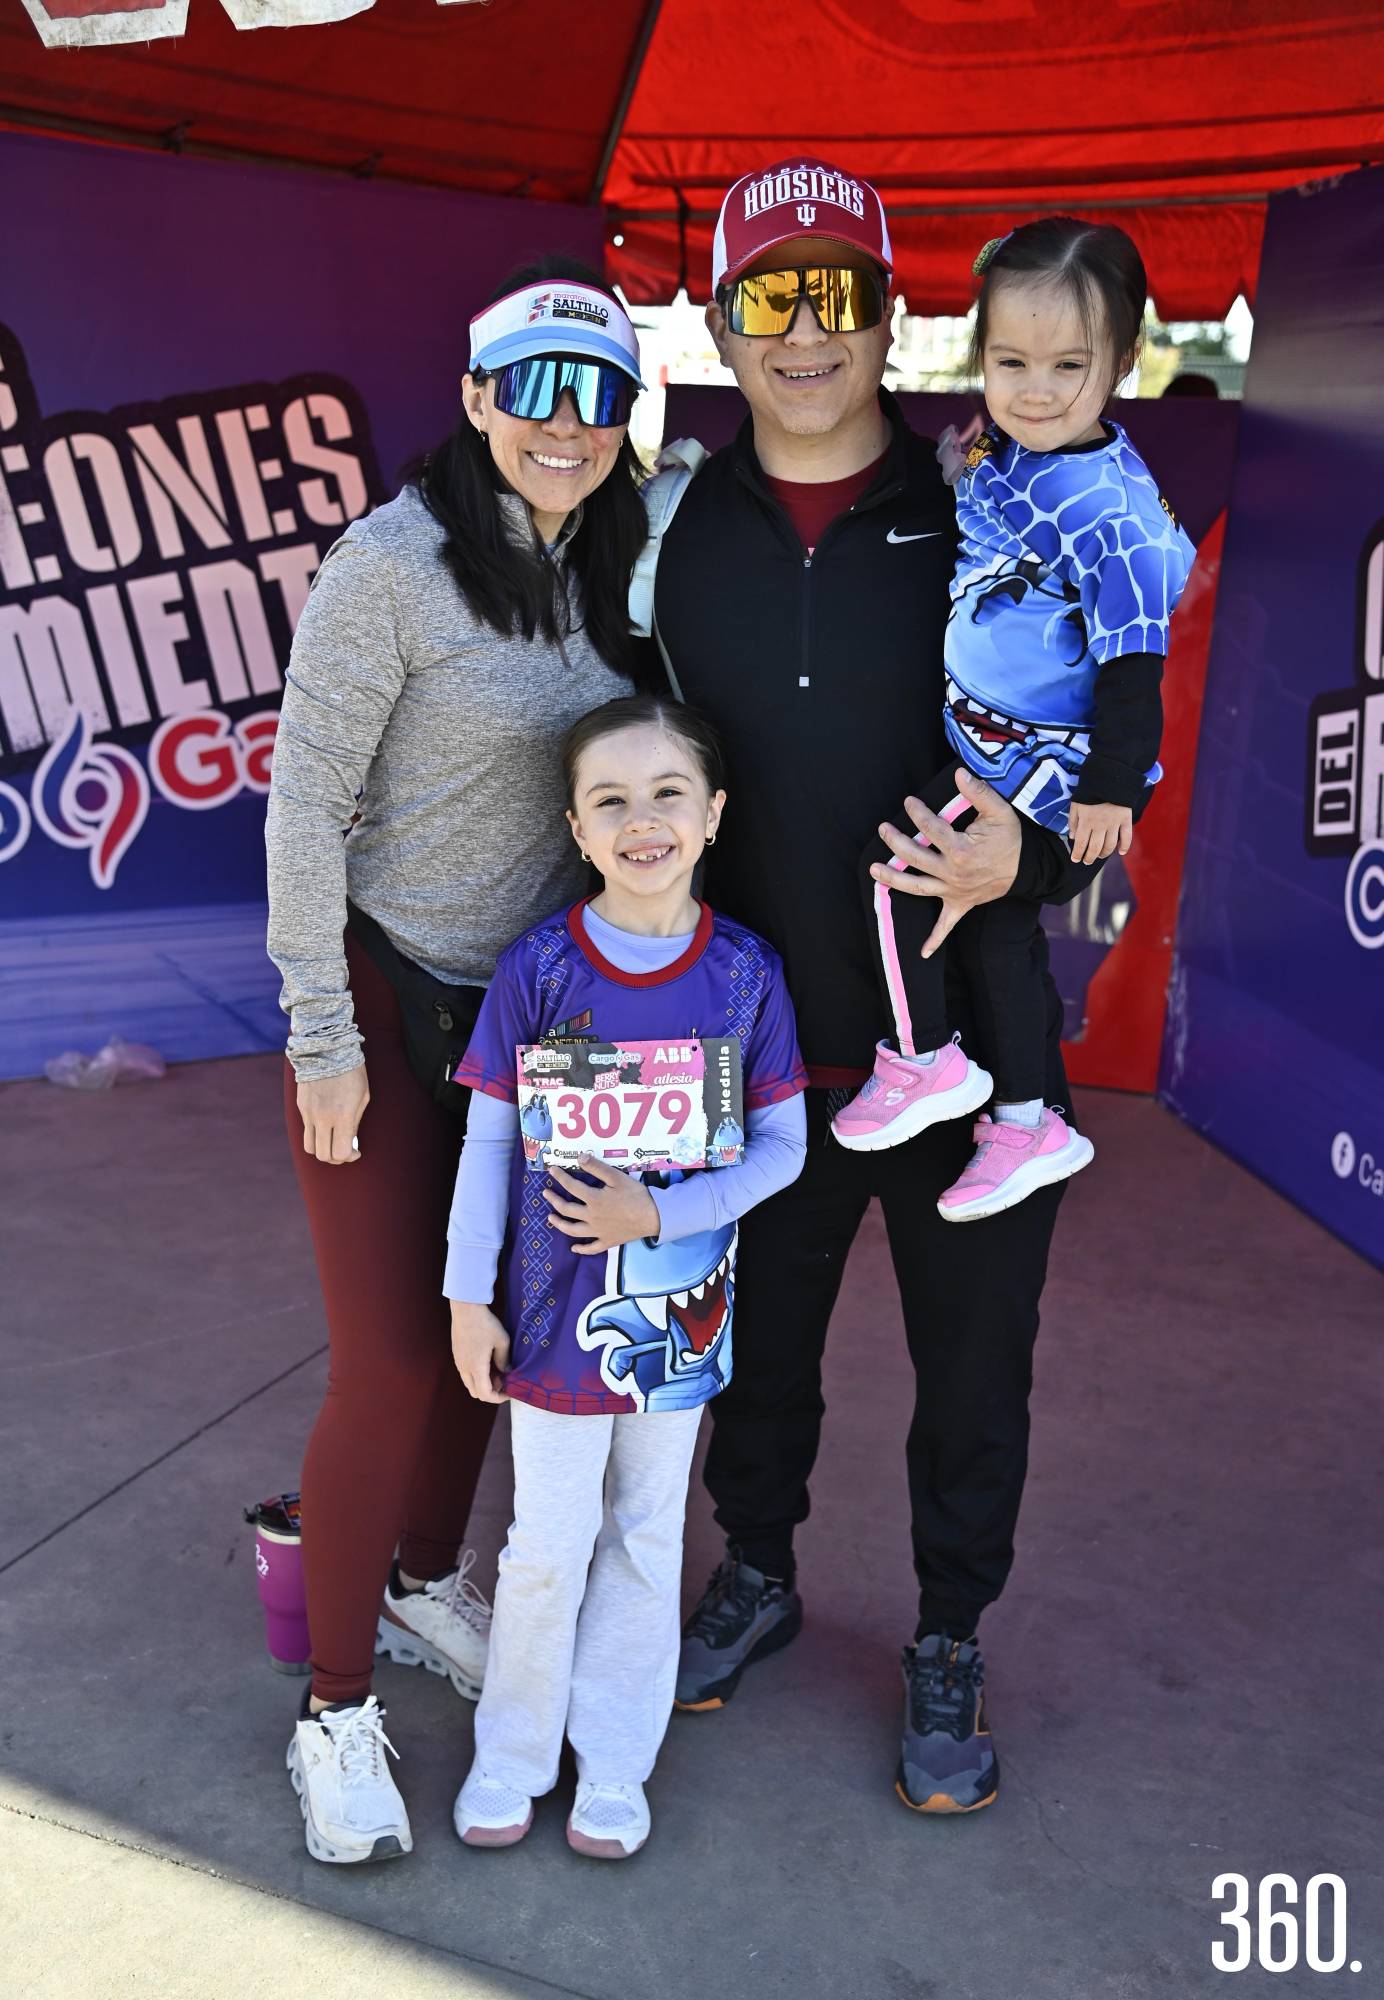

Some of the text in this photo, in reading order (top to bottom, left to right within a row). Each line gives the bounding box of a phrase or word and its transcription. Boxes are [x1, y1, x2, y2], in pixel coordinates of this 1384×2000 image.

[743, 171, 864, 218] HOOSIERS
[552, 298, 609, 318] SALTILLO
[1317, 719, 1357, 827] DEL
[536, 1053, 572, 1063] SALTILLO
[653, 1046, 693, 1065] ABB
[594, 1071, 620, 1083] BERRY
[718, 1045, 732, 1113] Medalla
[557, 1089, 692, 1139] 3079
